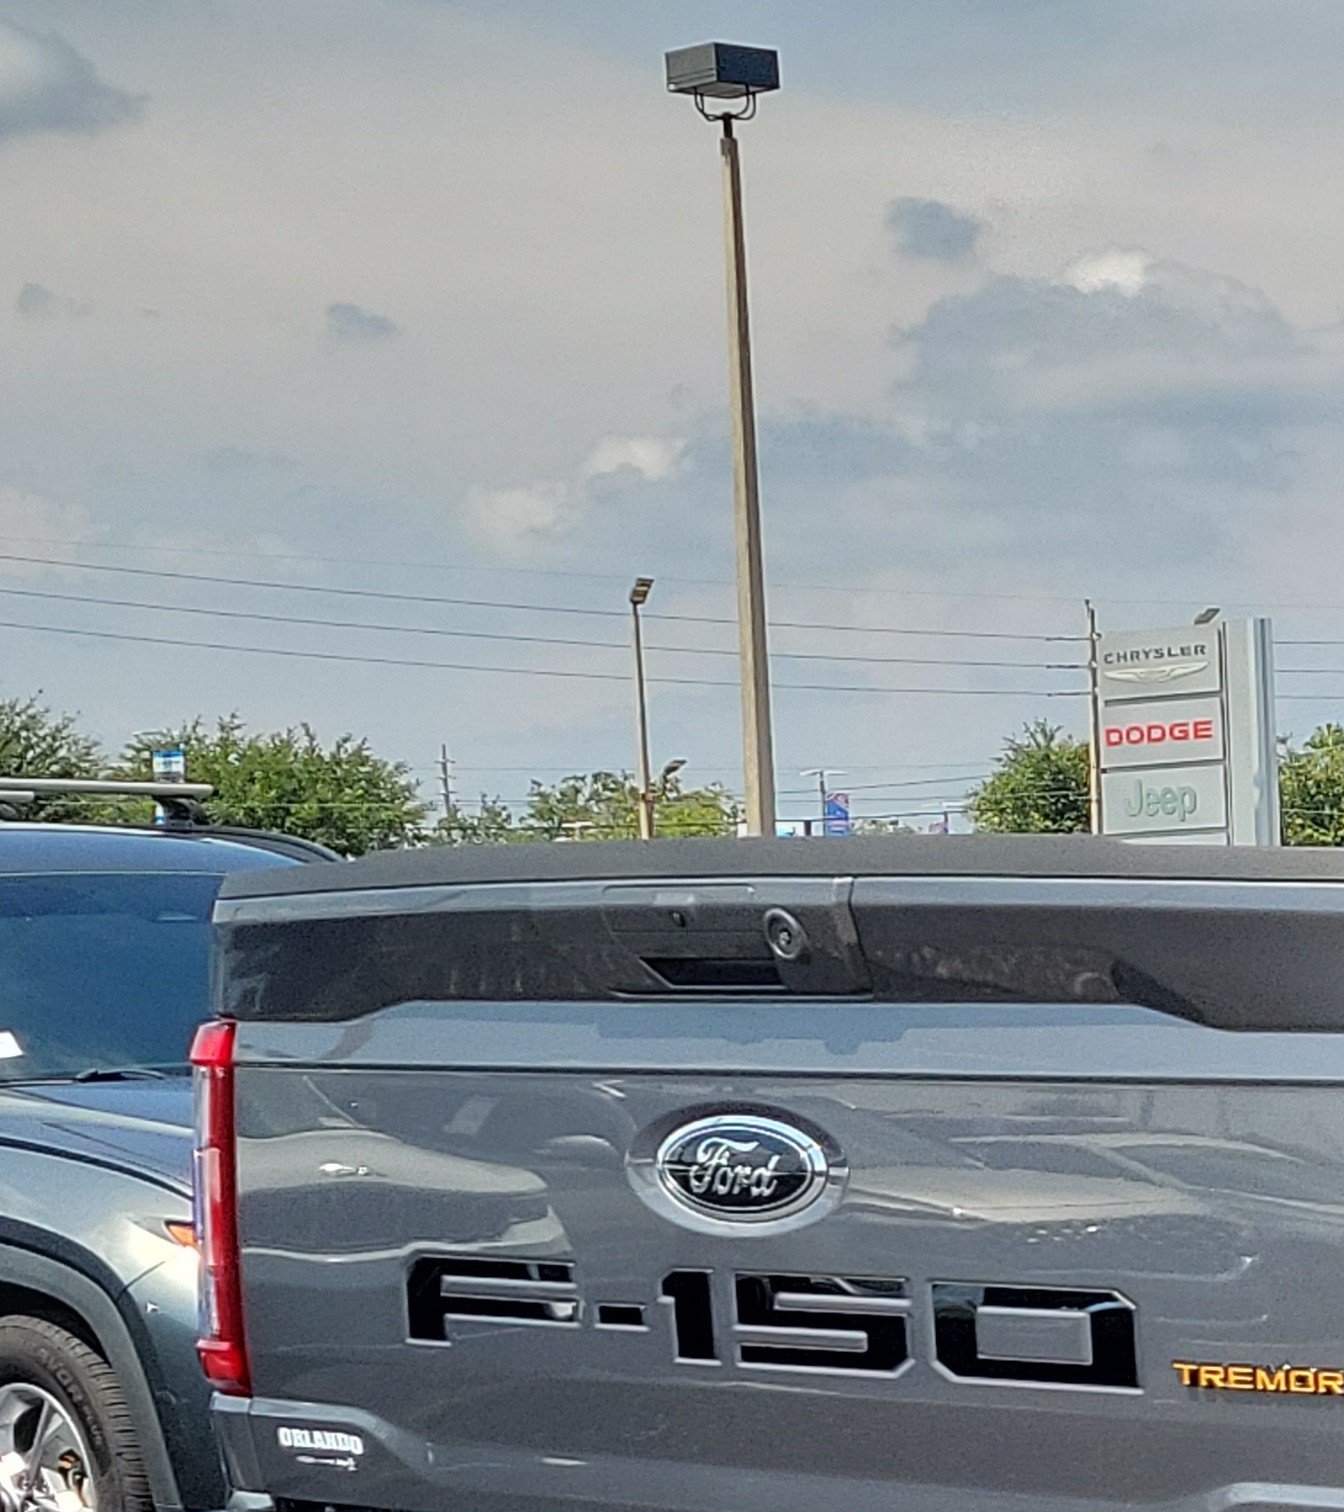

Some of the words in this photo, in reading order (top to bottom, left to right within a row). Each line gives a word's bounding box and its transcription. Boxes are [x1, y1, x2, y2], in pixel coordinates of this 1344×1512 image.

[1103, 644, 1207, 665] CHRYSLER
[1105, 720, 1214, 747] DODGE
[1124, 778, 1198, 822] Jeep
[688, 1136, 781, 1197] Ford
[404, 1250, 1145, 1395] F-150
